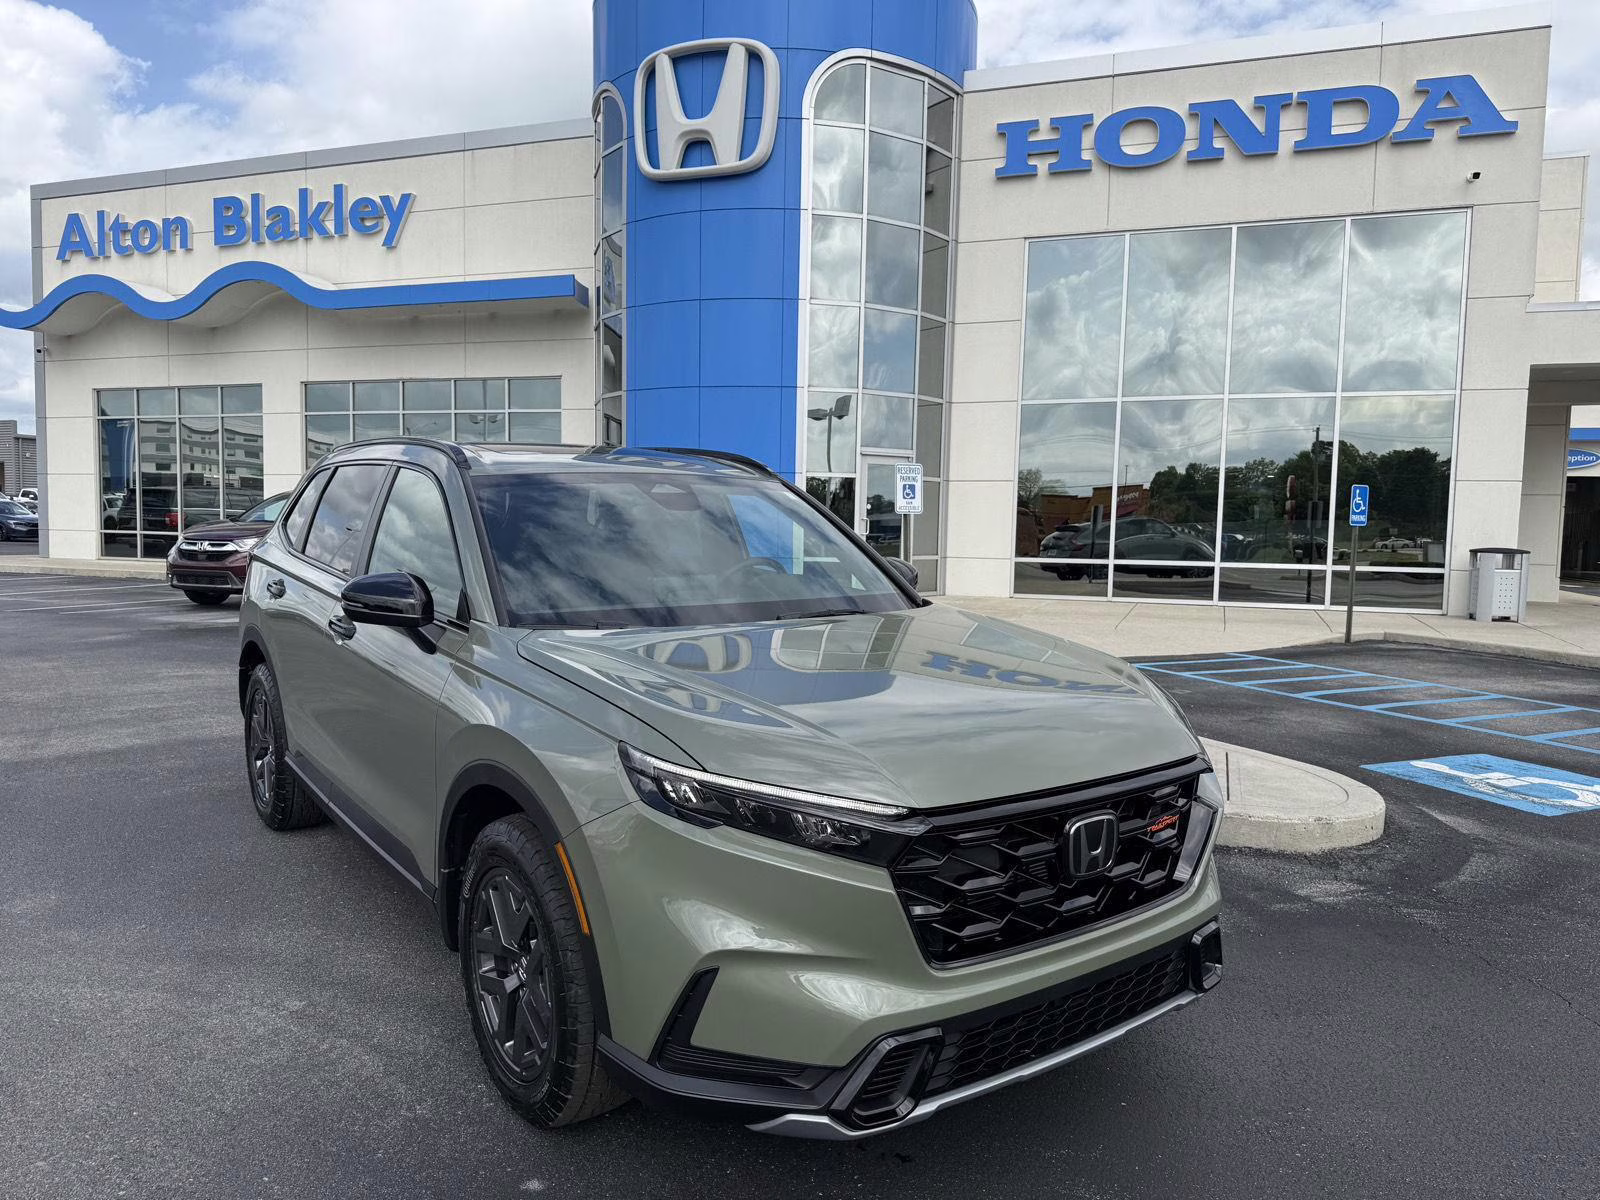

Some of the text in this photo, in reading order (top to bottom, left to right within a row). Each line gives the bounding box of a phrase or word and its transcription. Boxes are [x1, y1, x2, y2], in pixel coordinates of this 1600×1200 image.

[995, 74, 1519, 178] HONDA
[55, 183, 416, 262] Alton Blakley
[898, 466, 920, 475] RESERVED
